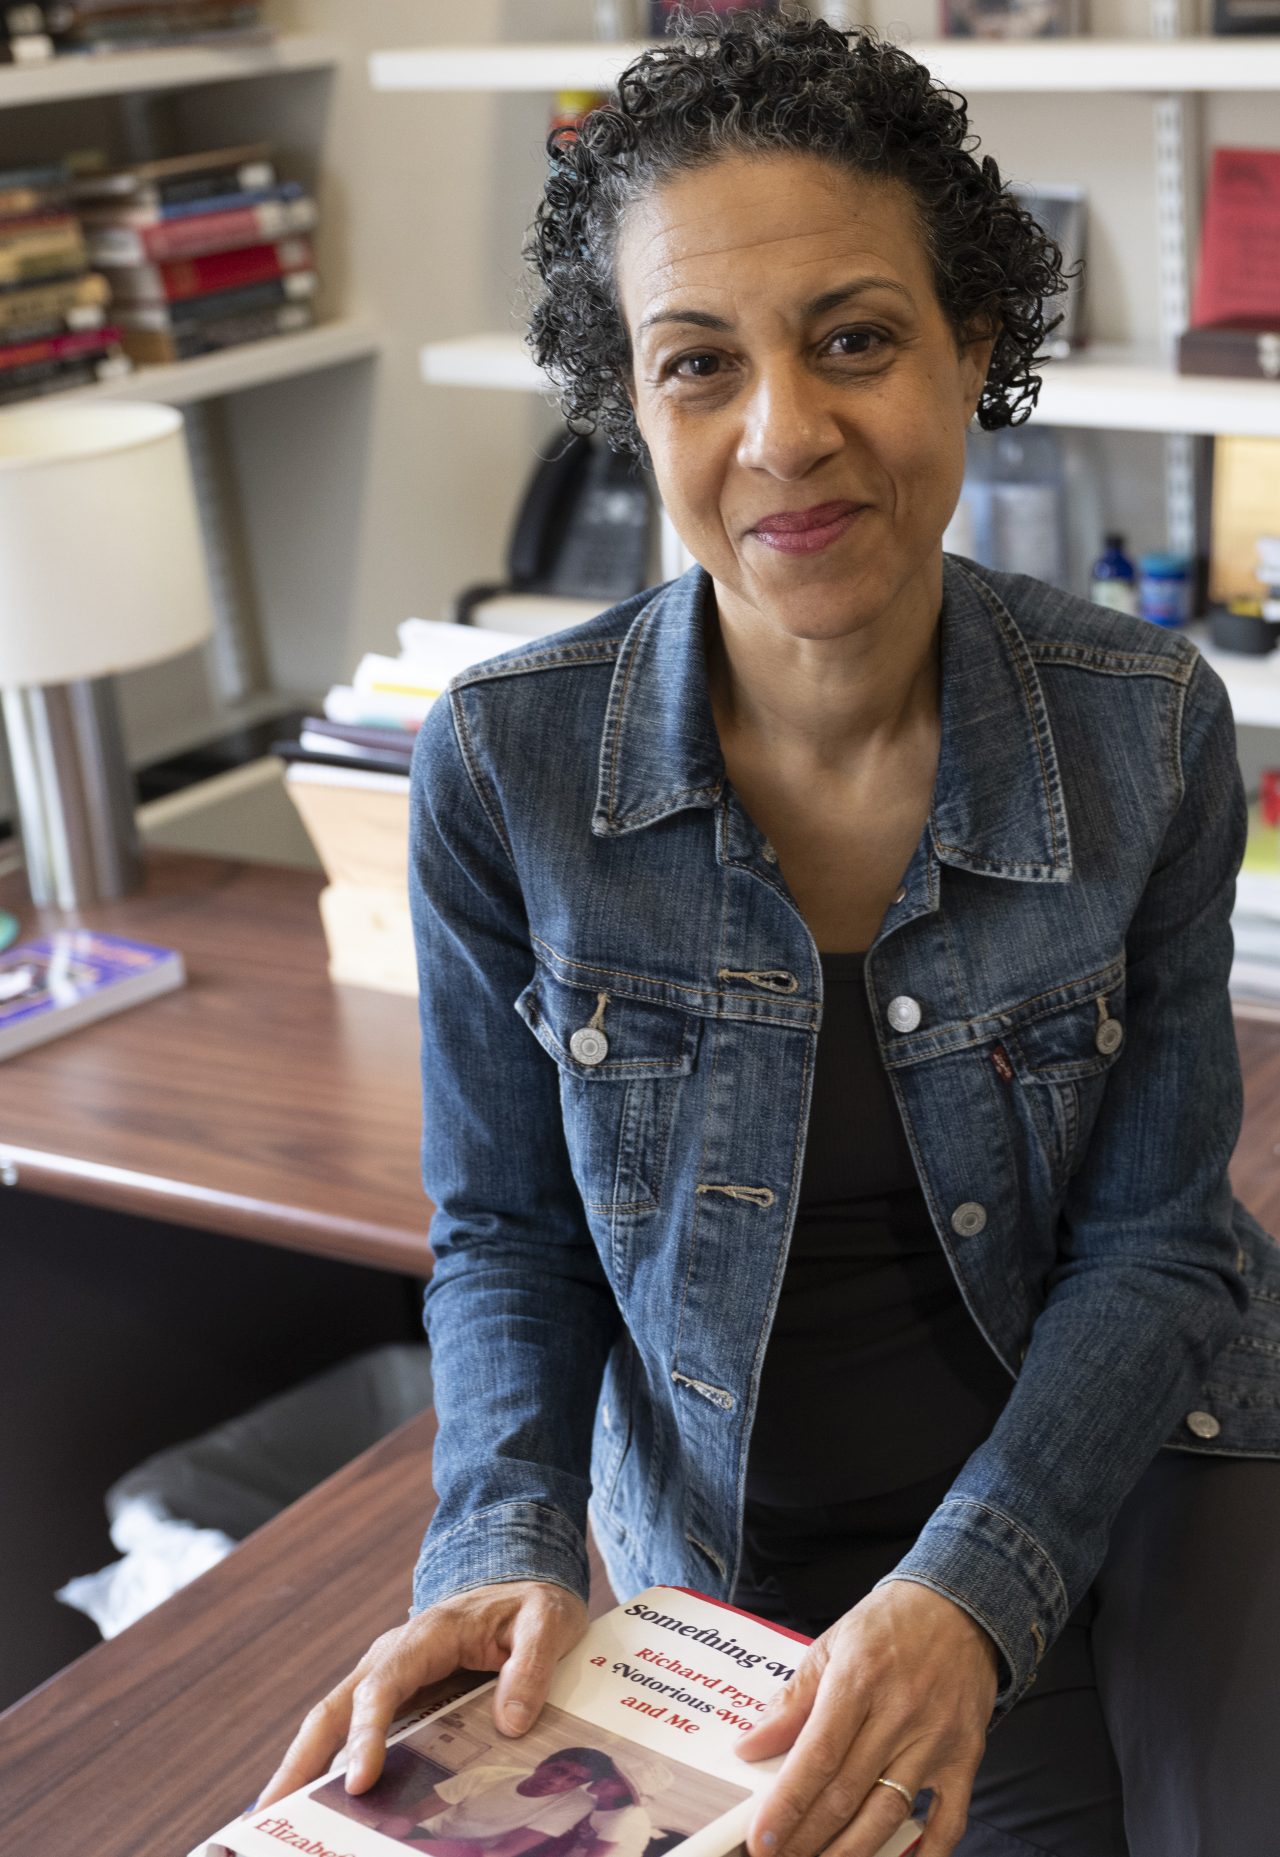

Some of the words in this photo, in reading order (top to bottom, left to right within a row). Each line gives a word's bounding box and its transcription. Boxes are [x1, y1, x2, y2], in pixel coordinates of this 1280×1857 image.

[625, 1604, 767, 1669] Something
[765, 1661, 796, 1682] W
[590, 1655, 607, 1669] a
[612, 1662, 715, 1713] Notorious
[715, 1708, 754, 1731] Wo
[635, 1647, 722, 1690] Richard
[719, 1684, 768, 1712] Pryo
[620, 1696, 668, 1719] and
[664, 1713, 700, 1735] Me
